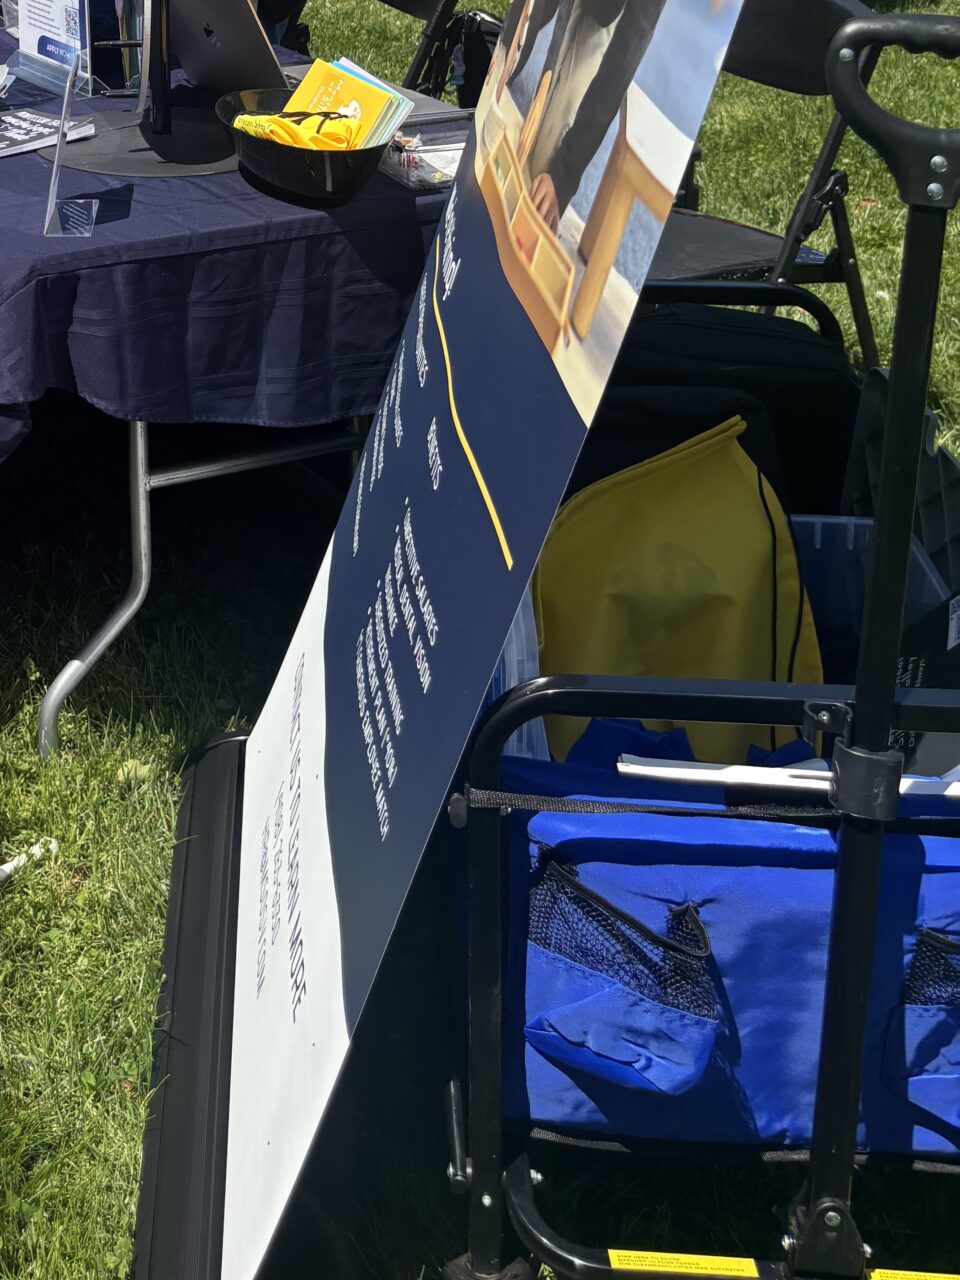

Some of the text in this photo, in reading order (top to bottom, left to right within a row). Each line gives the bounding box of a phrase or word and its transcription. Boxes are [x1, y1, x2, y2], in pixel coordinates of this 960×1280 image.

[46, 43, 59, 55] APPLY
[404, 507, 438, 646] COMPETITIVE SALARIES
[384, 660, 404, 736] TRAINING
[413, 634, 432, 695] VISION
[374, 689, 387, 737] PLAN
[290, 738, 301, 792] US
[361, 710, 381, 791] EMPLOYEE
[375, 782, 390, 843] MATCH
[289, 775, 301, 828] TO
[288, 813, 300, 925] LEARN
[289, 910, 307, 1024] MORE
